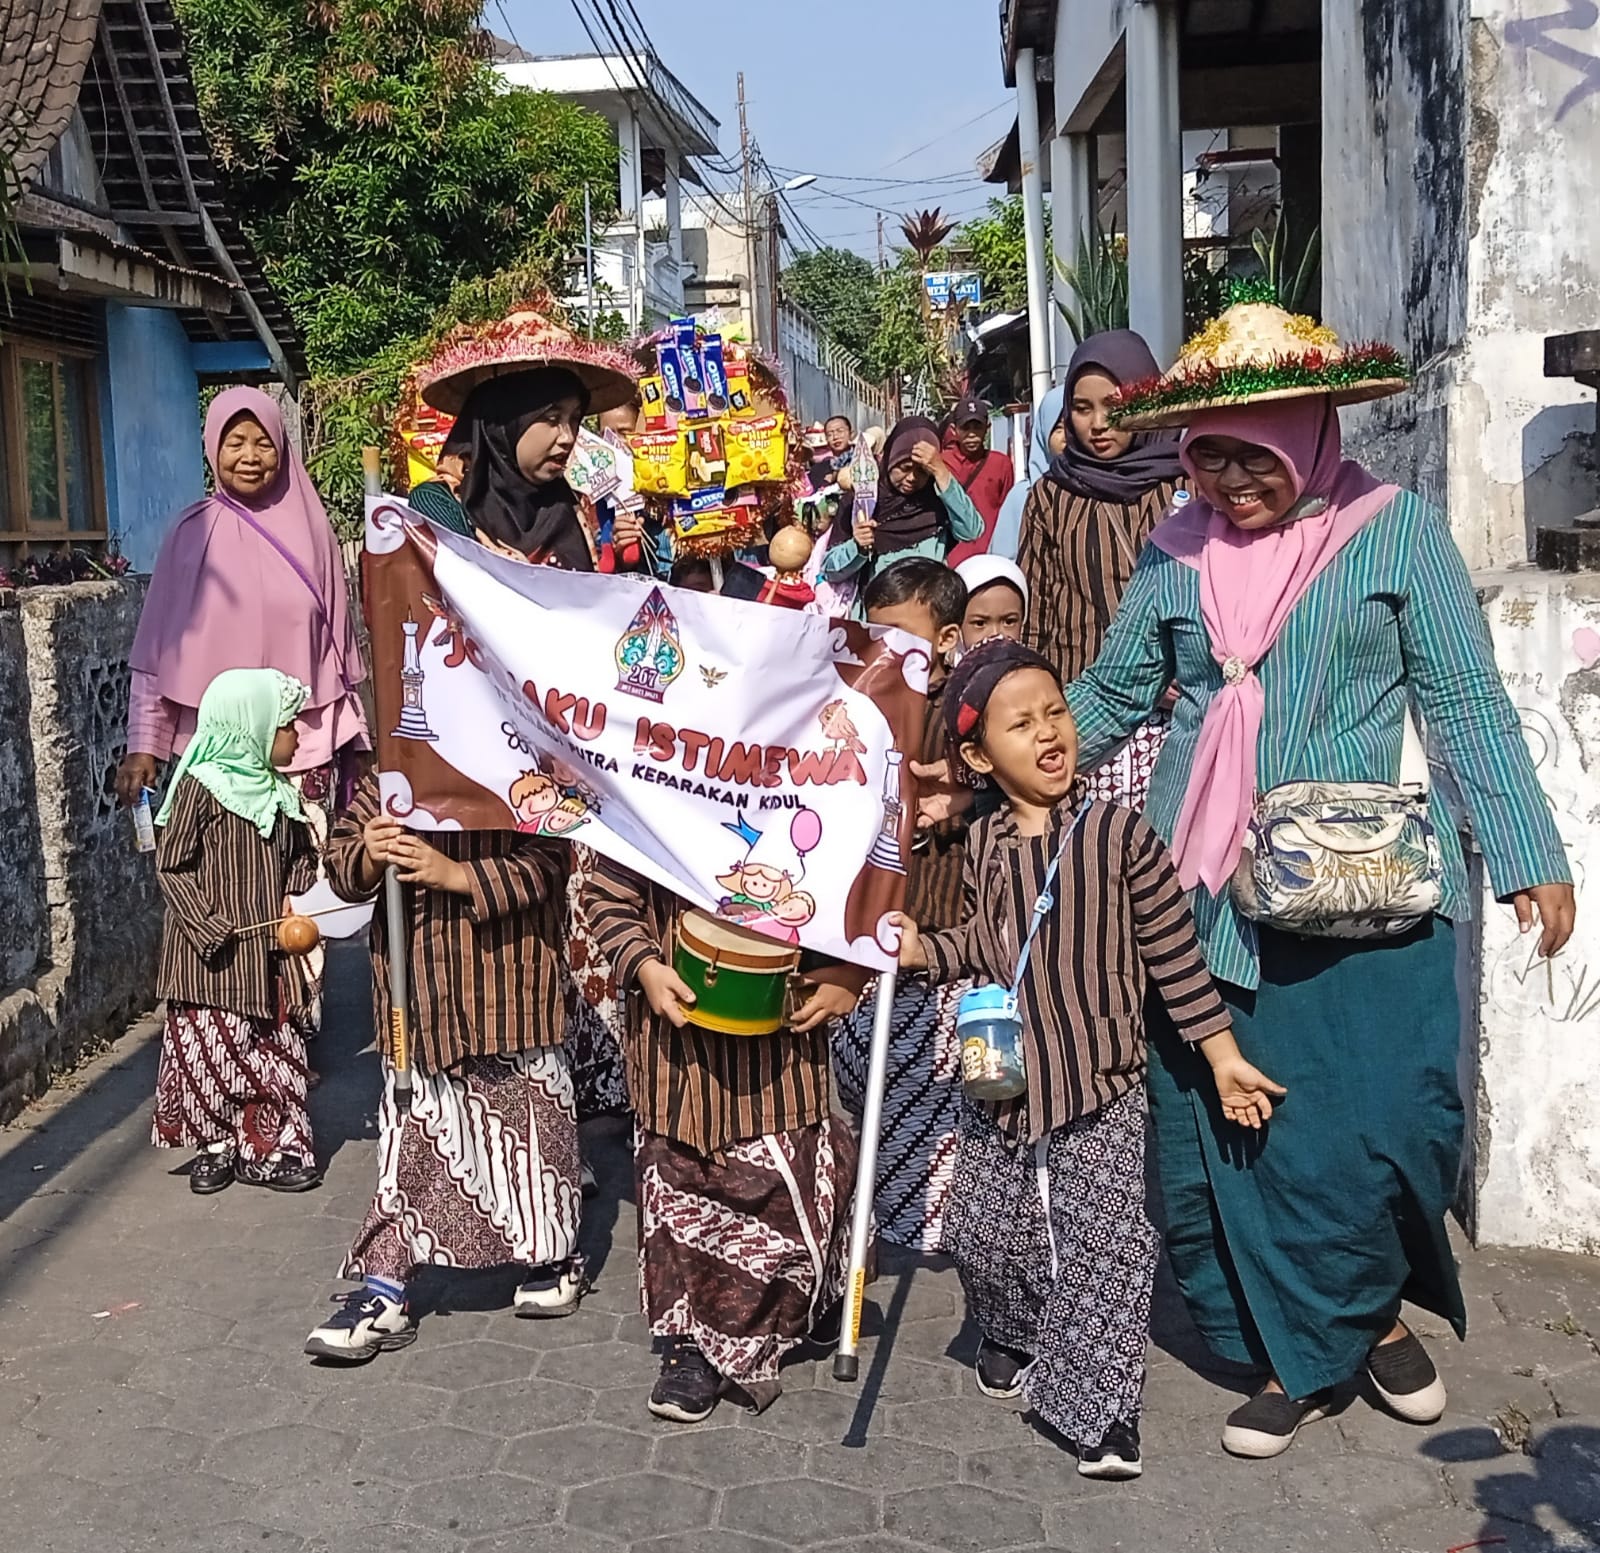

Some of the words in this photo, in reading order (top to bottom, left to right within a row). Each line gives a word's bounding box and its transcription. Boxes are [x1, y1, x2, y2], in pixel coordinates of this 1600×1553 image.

[663, 362, 679, 398] OREO
[706, 360, 723, 396] OREO
[637, 445, 671, 460] CHIKI
[737, 429, 770, 447] CHIKI
[691, 491, 724, 509] OREO
[628, 664, 658, 688] 267
[443, 631, 607, 741] JOAKU
[633, 716, 867, 788] ISTIMEWA
[567, 742, 618, 773] PUTRA
[632, 764, 748, 809] KEPARAKAN
